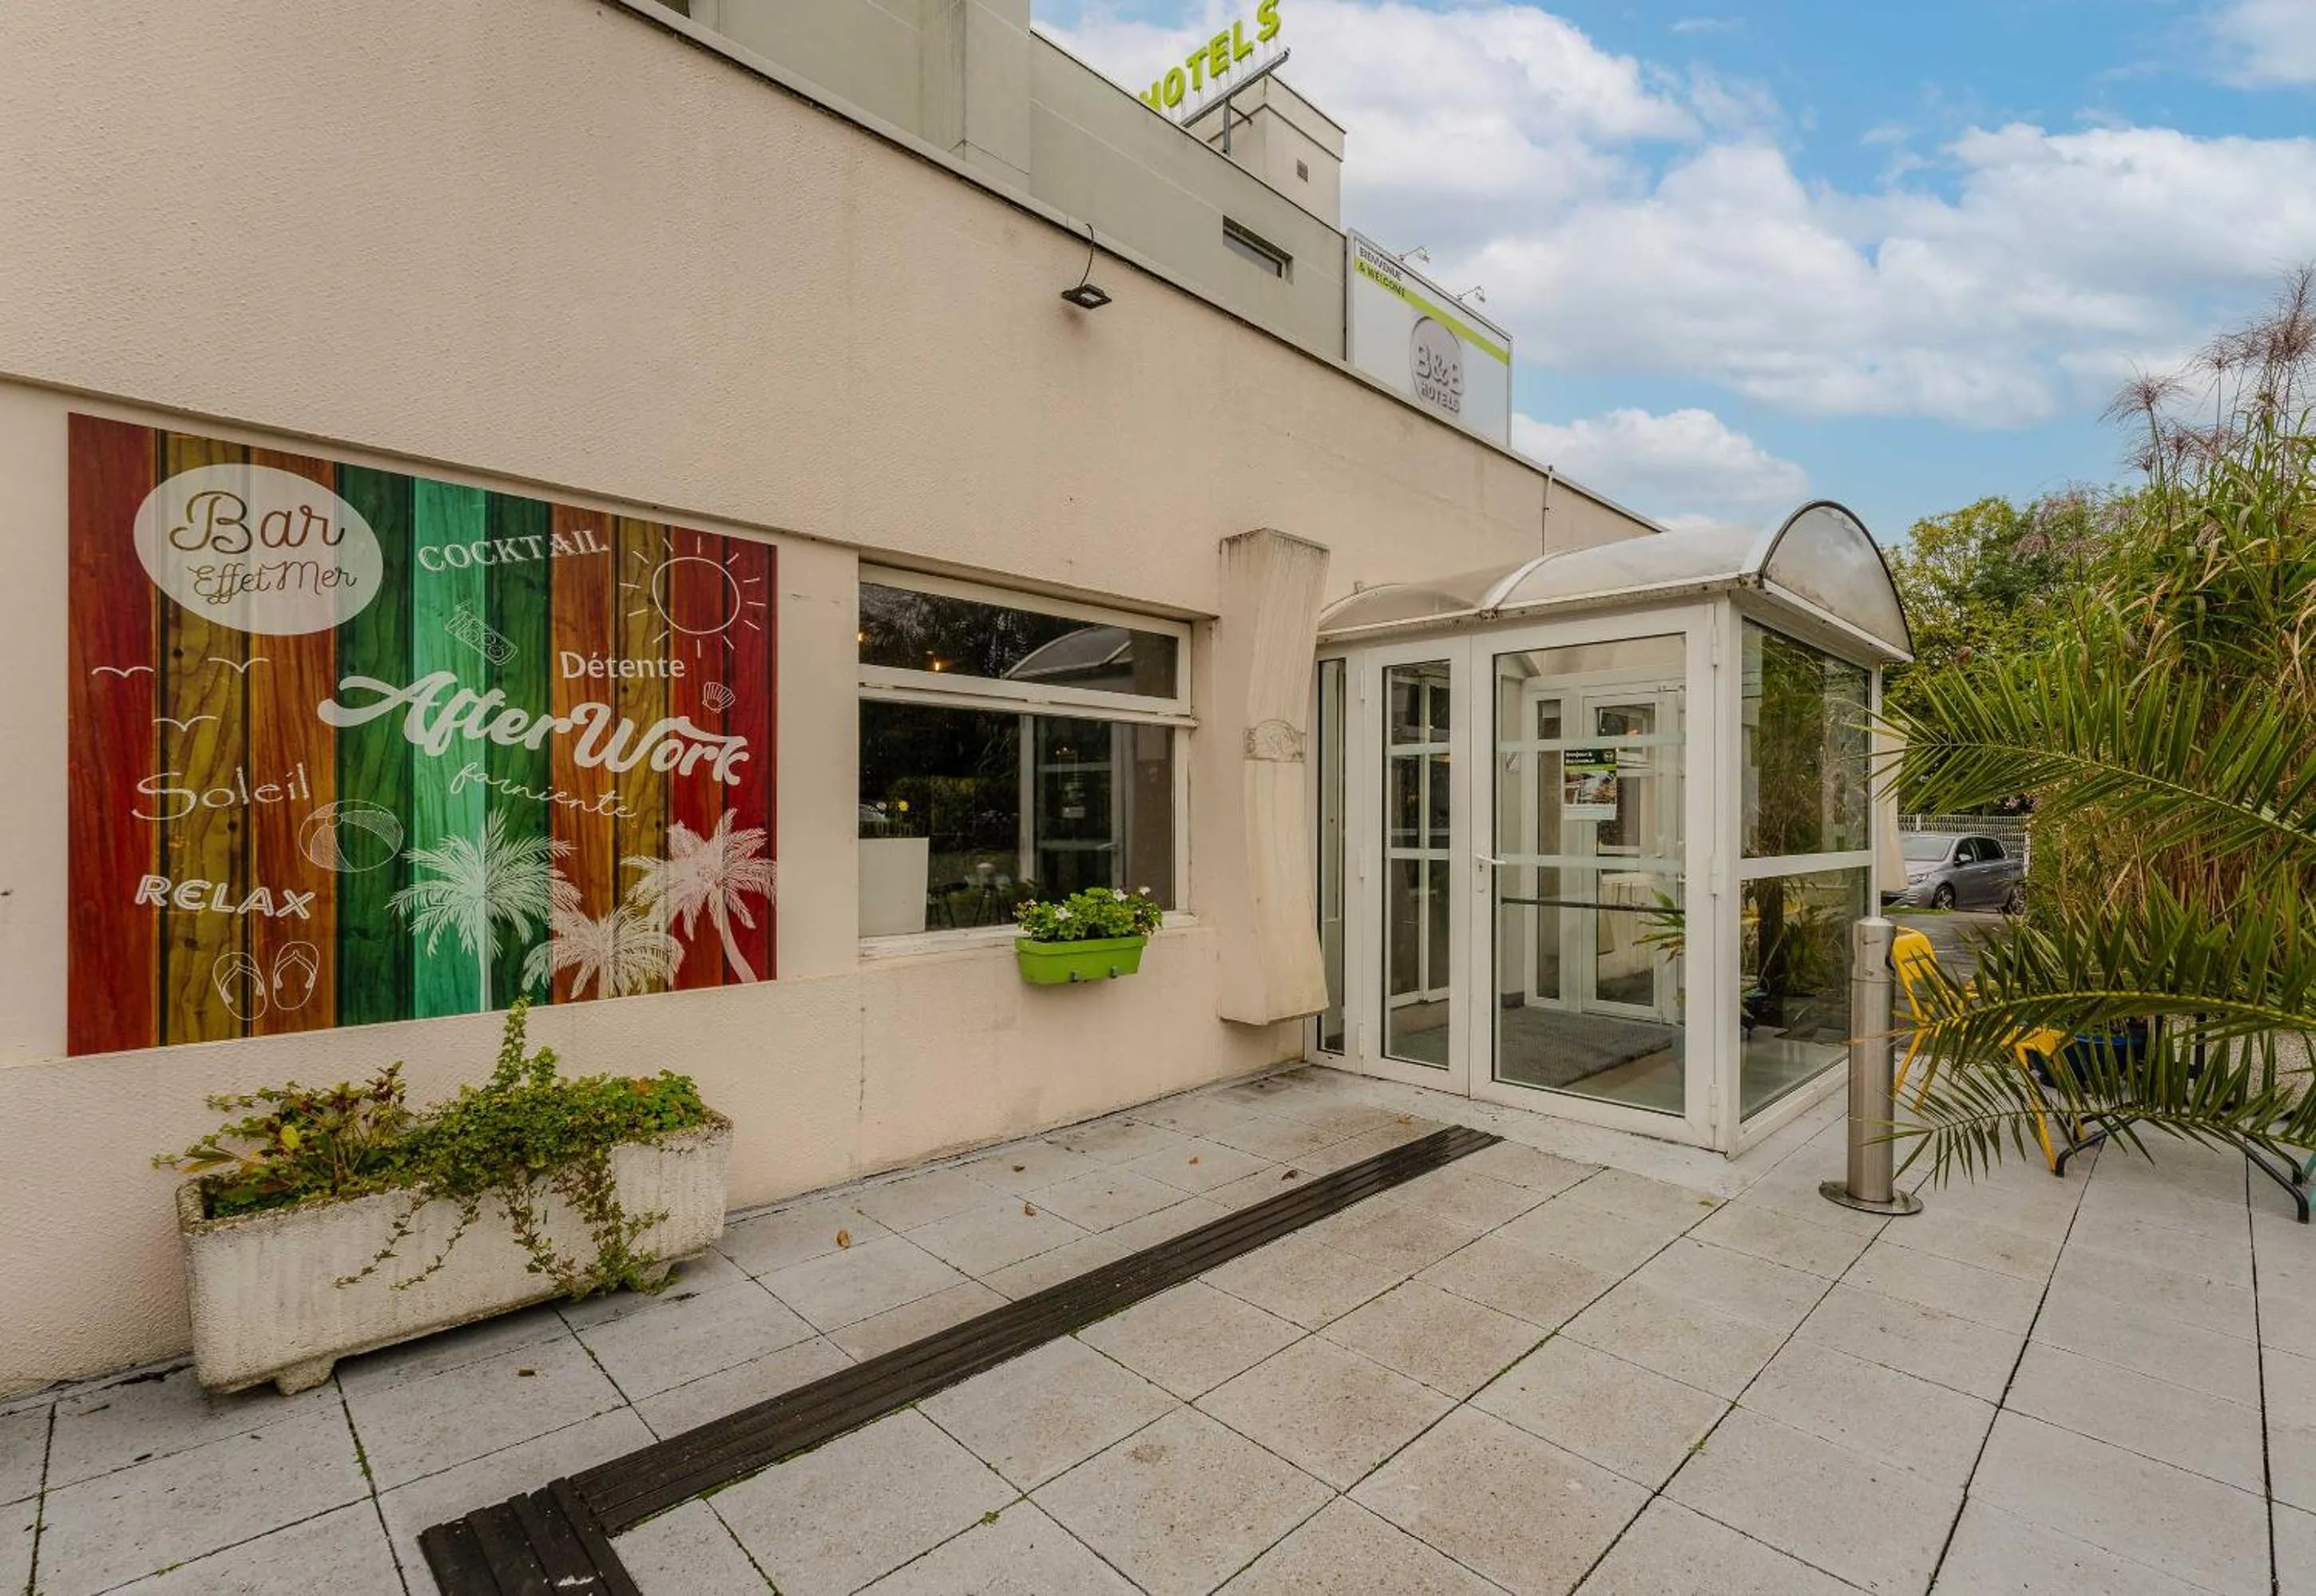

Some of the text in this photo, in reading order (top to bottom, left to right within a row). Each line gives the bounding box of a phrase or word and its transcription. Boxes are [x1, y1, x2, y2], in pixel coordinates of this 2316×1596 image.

[1359, 246, 1402, 282] BIENVENUE
[1367, 266, 1405, 298] WELCOME
[1416, 344, 1463, 396] B&B
[169, 490, 346, 555] Bar
[418, 529, 610, 572] COCKTAIL
[560, 650, 686, 679] Détente
[131, 761, 311, 821] Soleil
[450, 762, 638, 818] farniente
[134, 874, 315, 920] RELAX
